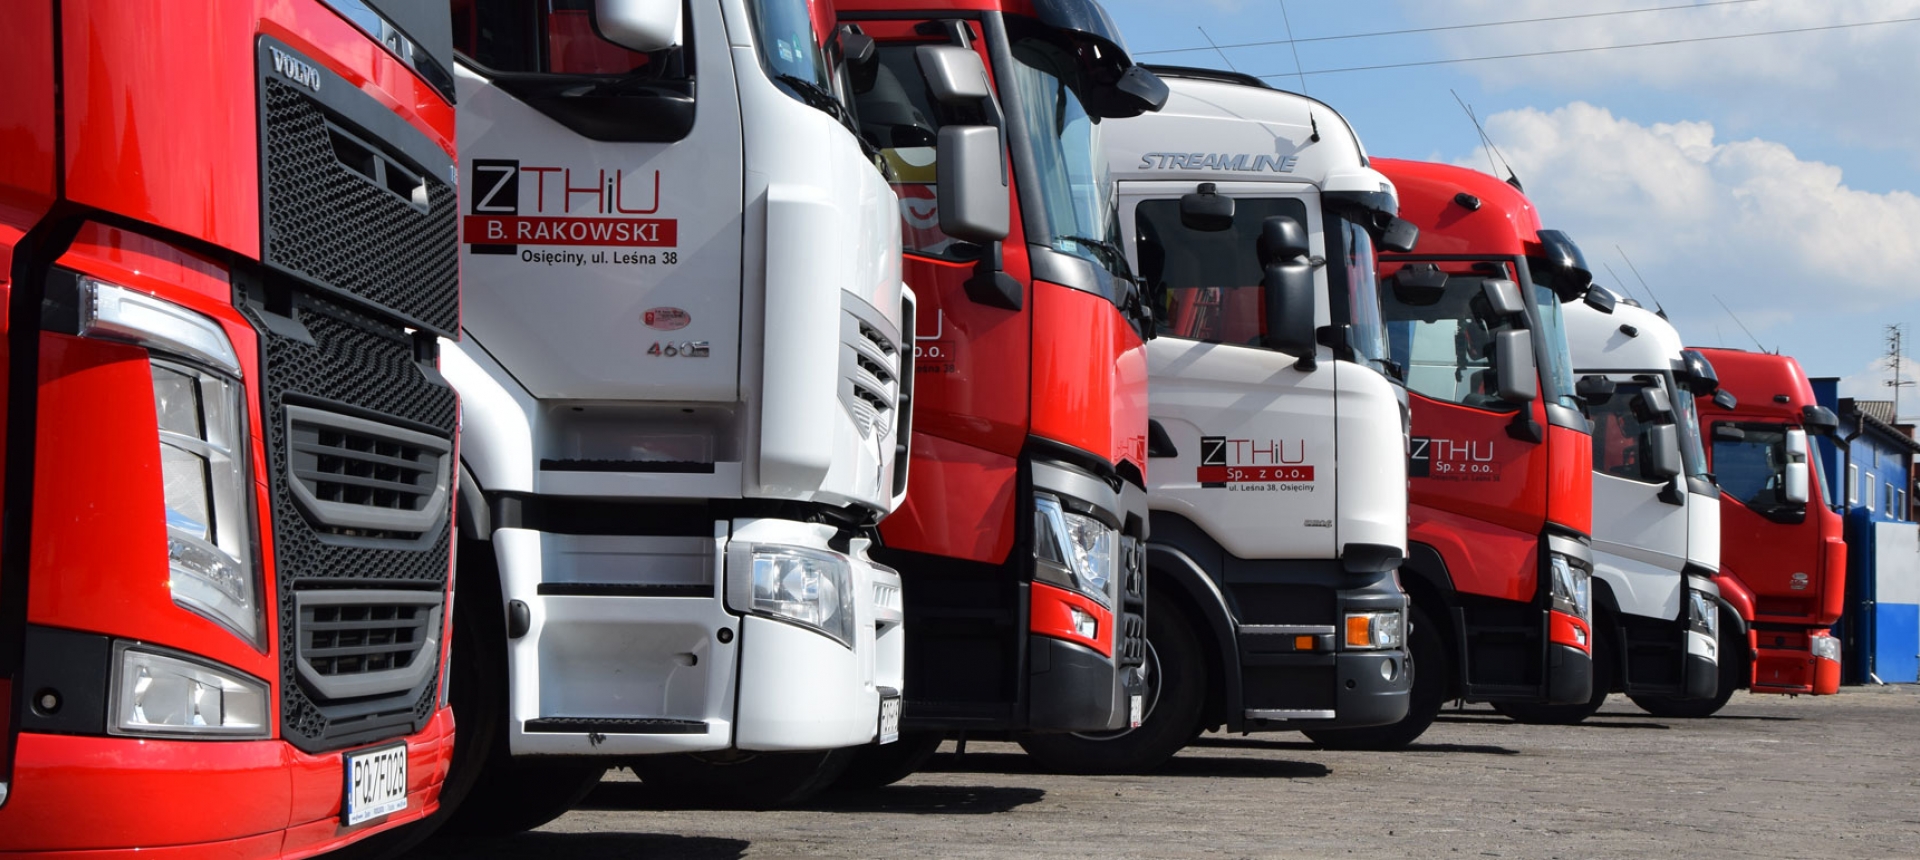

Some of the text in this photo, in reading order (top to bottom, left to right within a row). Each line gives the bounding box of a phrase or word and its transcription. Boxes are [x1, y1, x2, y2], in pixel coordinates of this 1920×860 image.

[269, 46, 321, 92] VOLVO
[1138, 152, 1299, 173] STREAMLINE
[476, 165, 660, 214] ZTHiU
[487, 220, 660, 242] B. RAKOWSKI
[521, 249, 678, 266] Osięciny, ul. Leśna 38
[1202, 438, 1305, 465] ZTHiU
[1411, 438, 1494, 462] ZTHU
[1226, 467, 1305, 481] Sp. z o.o.
[1436, 461, 1493, 473] Sp. z o.o.
[1229, 484, 1239, 492] ul.
[1241, 484, 1265, 492] Leśna
[1280, 484, 1315, 493] Osięciny
